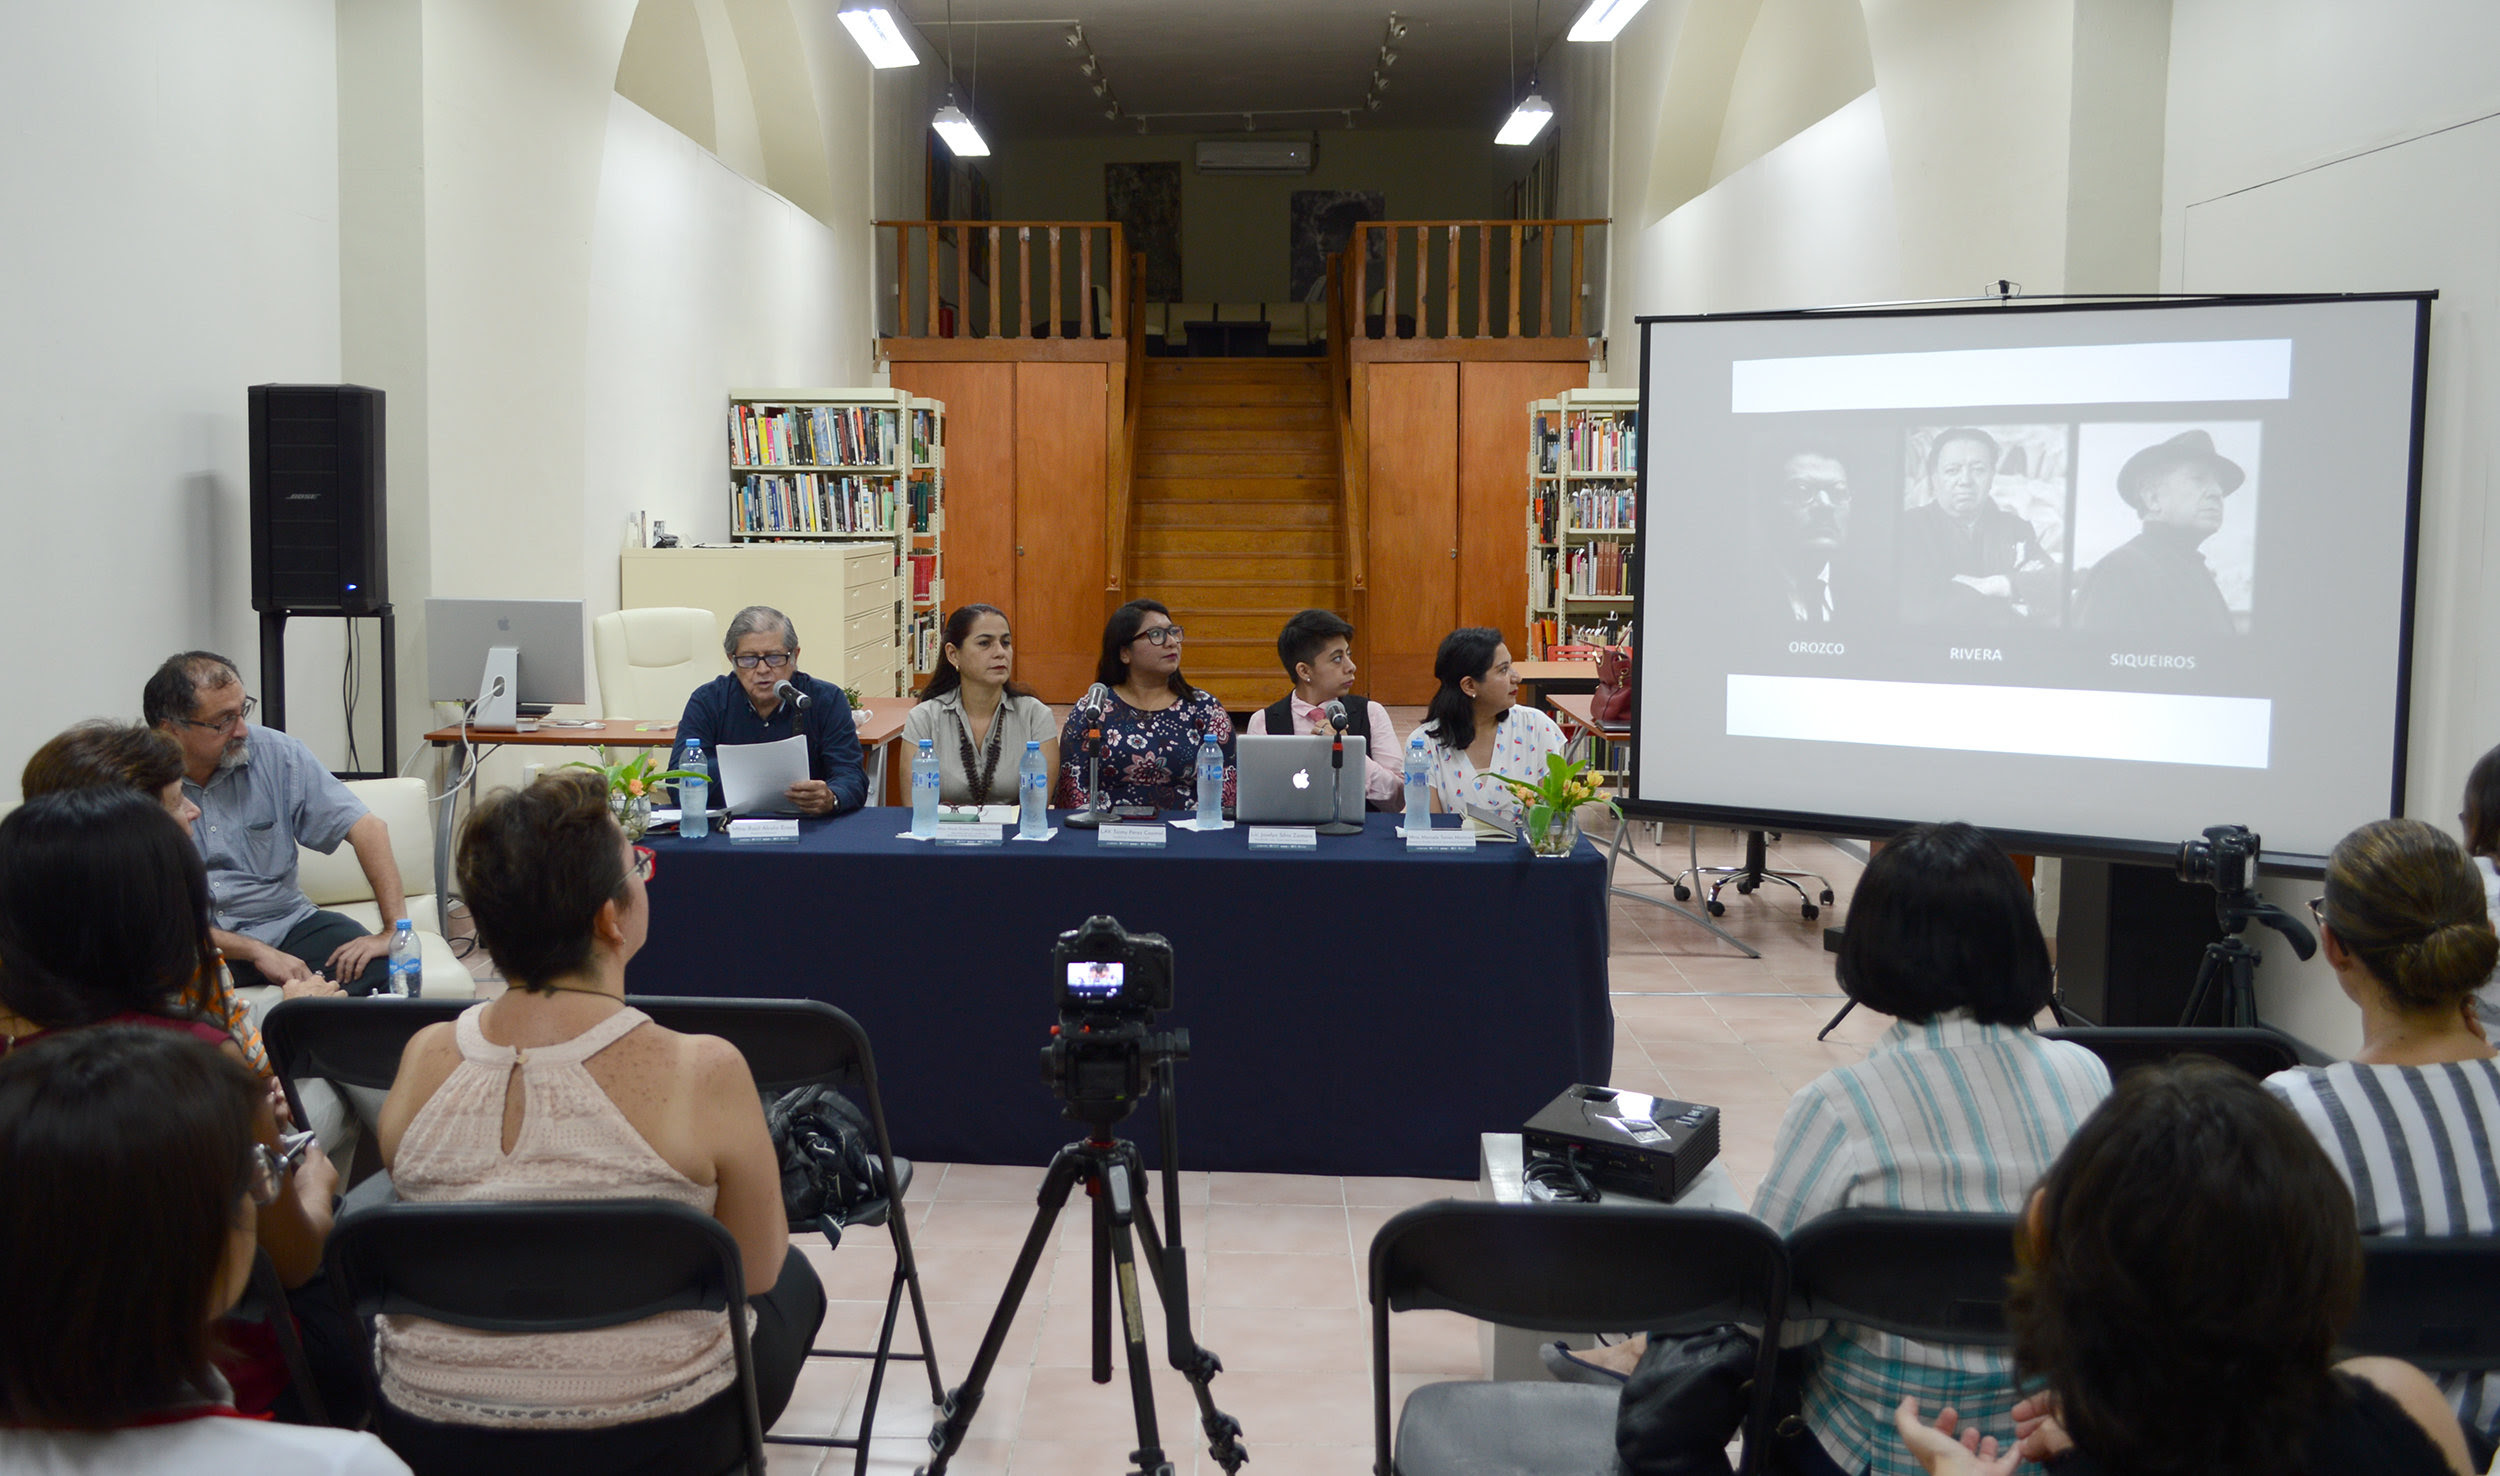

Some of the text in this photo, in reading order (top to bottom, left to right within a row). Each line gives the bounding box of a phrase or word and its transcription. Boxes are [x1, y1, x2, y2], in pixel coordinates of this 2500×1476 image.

[1788, 641, 1845, 655] OROZCO
[1950, 647, 2002, 661] RIVERA
[2110, 653, 2195, 669] SIQUEIROS
